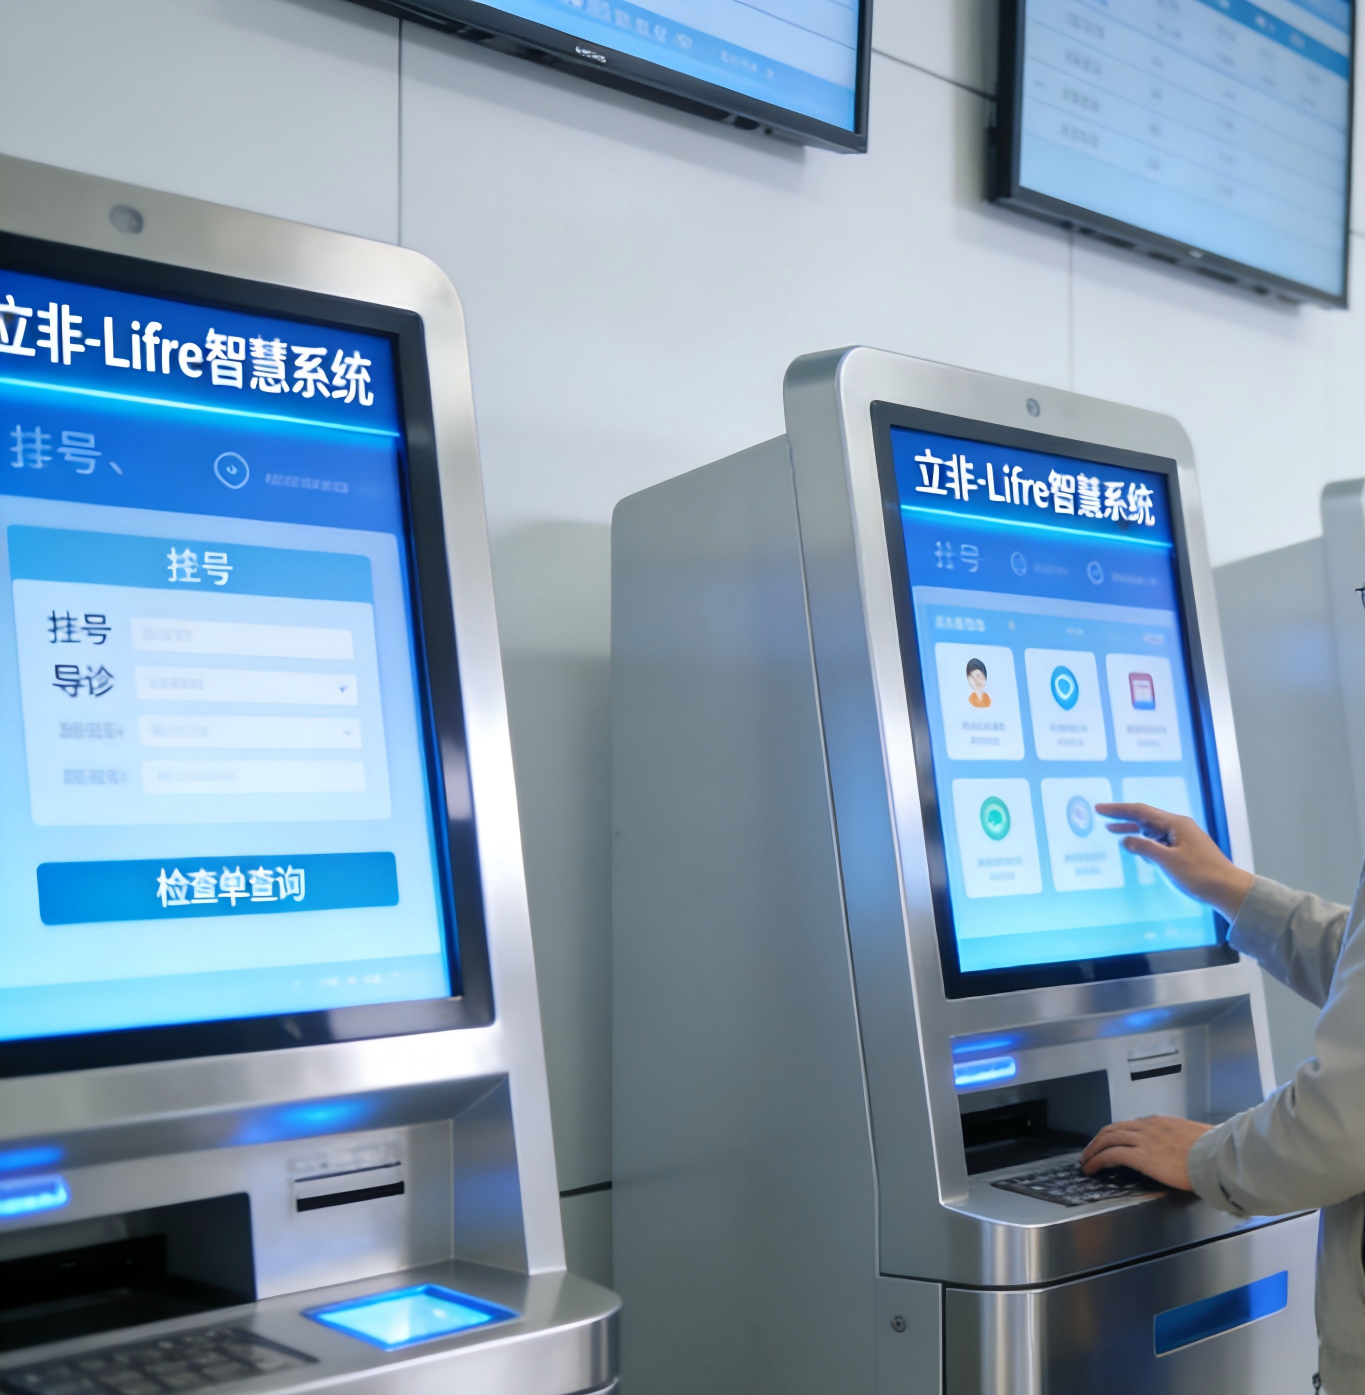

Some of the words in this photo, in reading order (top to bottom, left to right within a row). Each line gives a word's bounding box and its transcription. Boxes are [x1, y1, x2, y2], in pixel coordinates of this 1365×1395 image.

[0, 295, 374, 407] 立非-Lifre智慧系统
[914, 448, 1155, 527] 立非-Lifre智慧系统
[156, 864, 306, 908] 检查单查询
